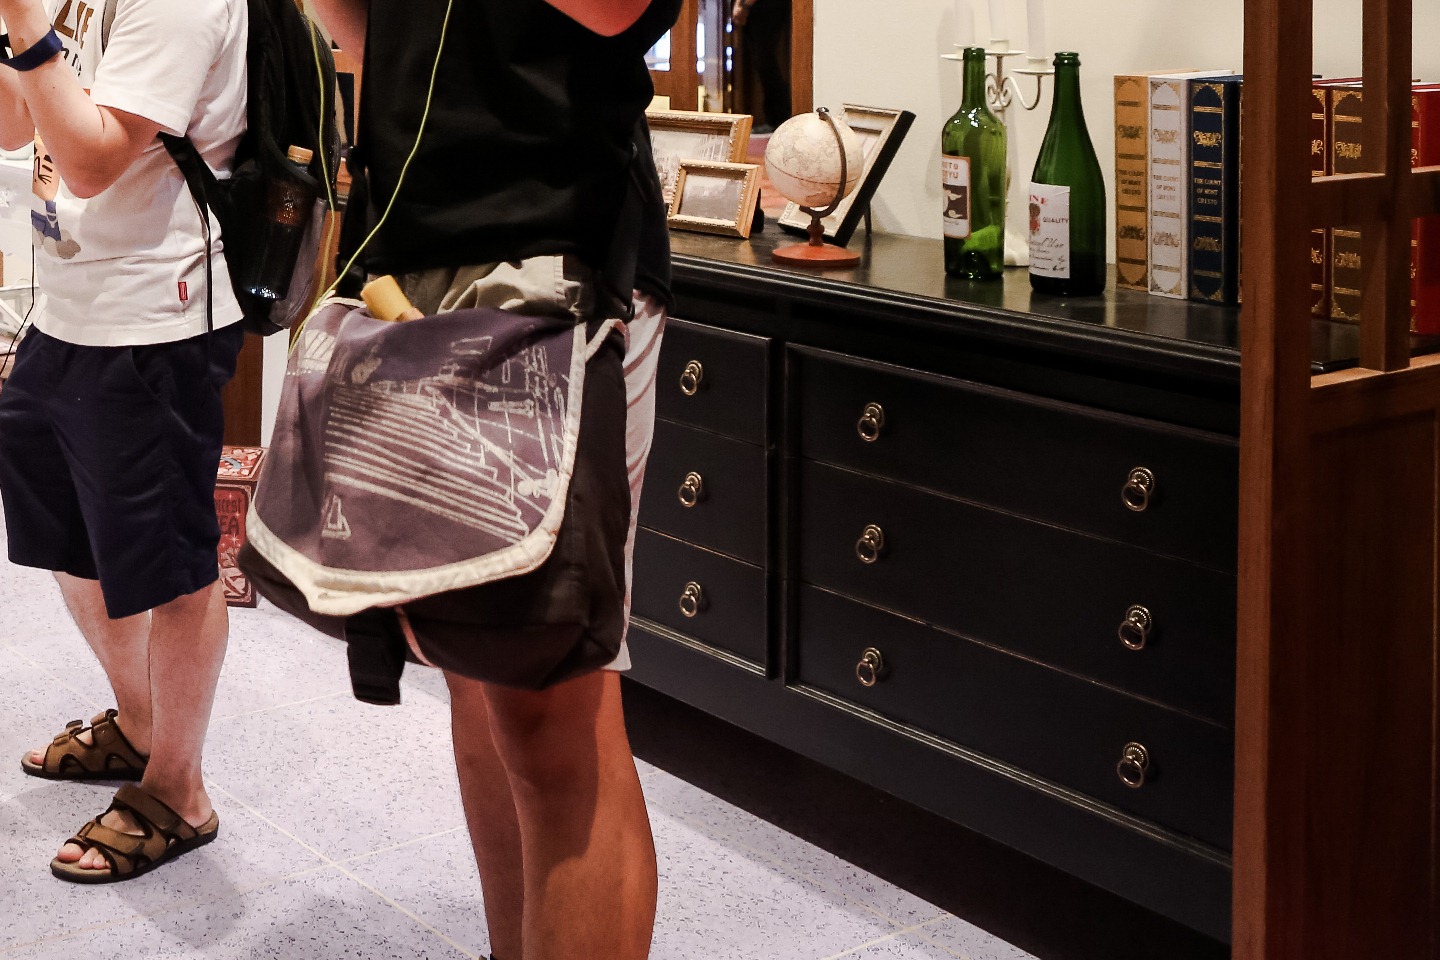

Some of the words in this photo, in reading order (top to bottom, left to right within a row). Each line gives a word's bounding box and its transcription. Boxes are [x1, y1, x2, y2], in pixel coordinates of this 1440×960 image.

[1204, 178, 1222, 186] COUNT
[1029, 194, 1048, 205] INE
[1197, 197, 1218, 206] CRISTO
[1042, 216, 1070, 224] QUALITY
[217, 515, 240, 536] EA
